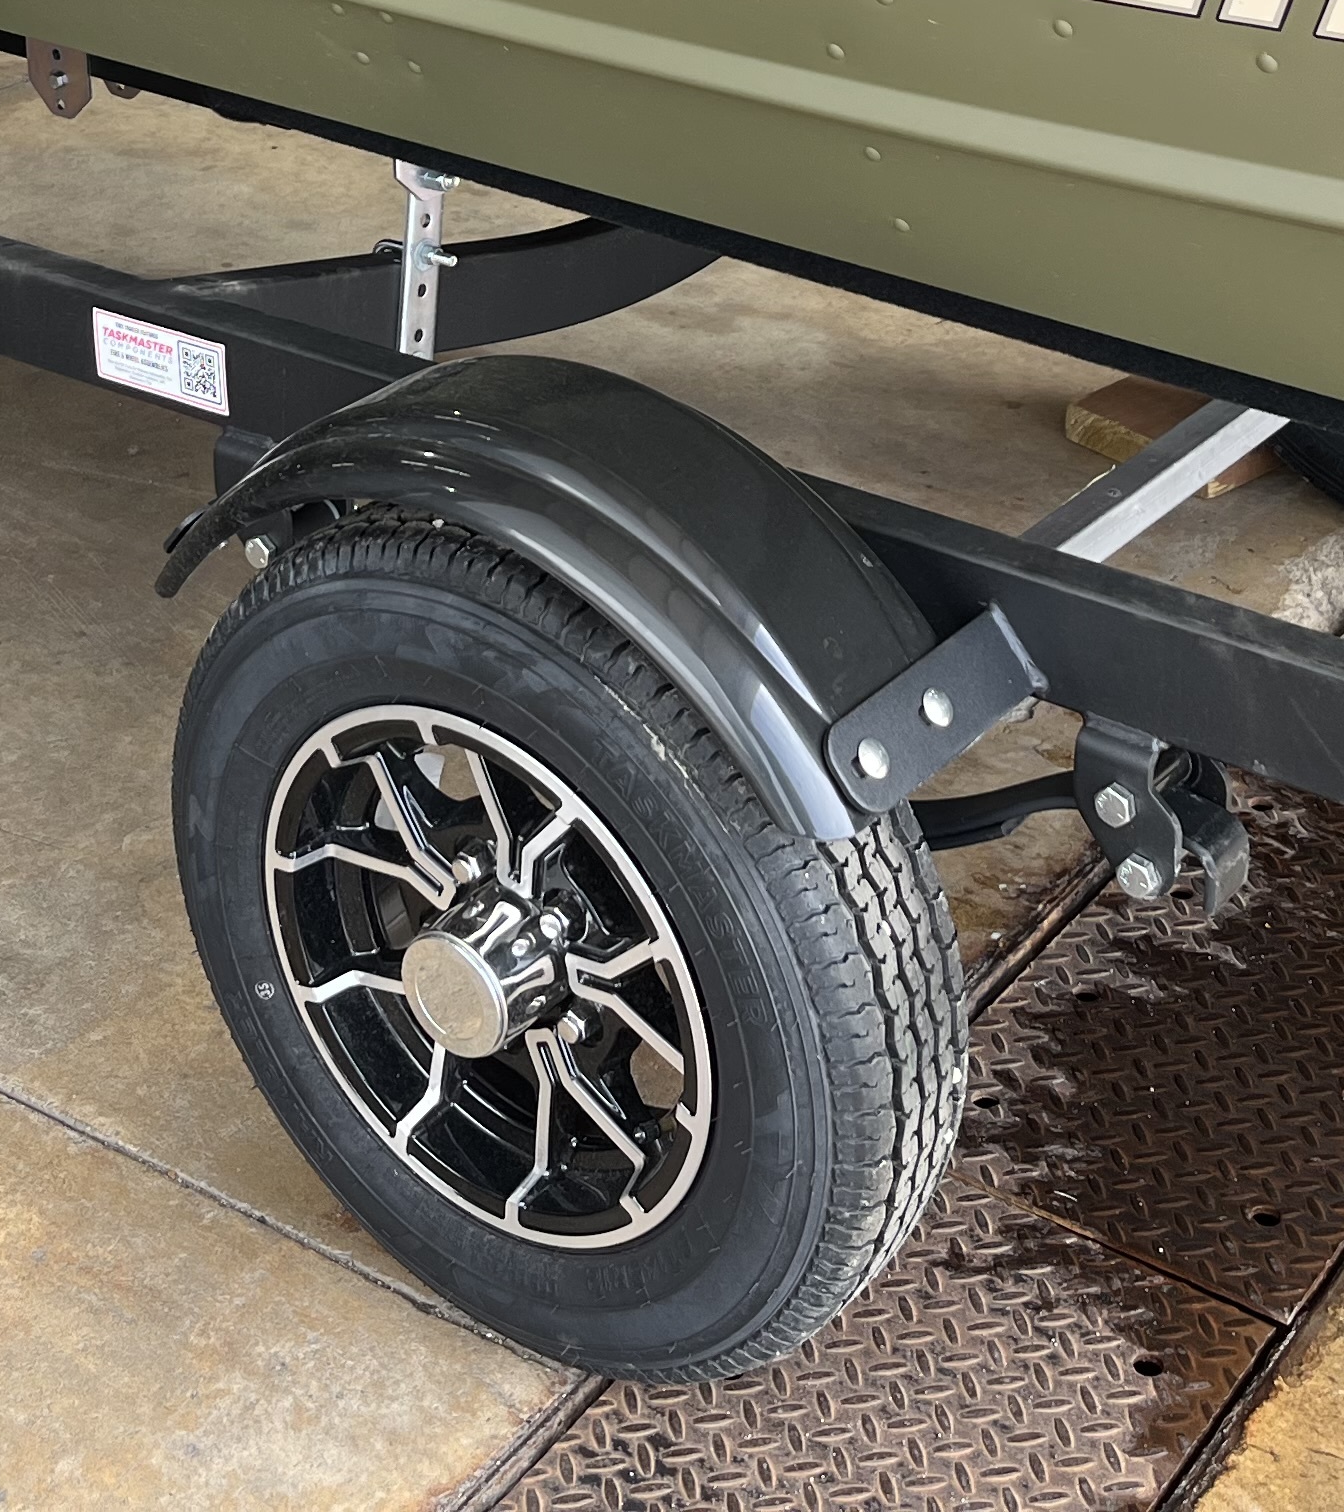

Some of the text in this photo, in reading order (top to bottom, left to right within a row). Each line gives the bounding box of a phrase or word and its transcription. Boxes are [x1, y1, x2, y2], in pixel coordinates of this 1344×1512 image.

[102, 326, 173, 355] TASKMASTER
[103, 338, 173, 364] COMPONENTS
[593, 734, 768, 1025] TASKMASTER
